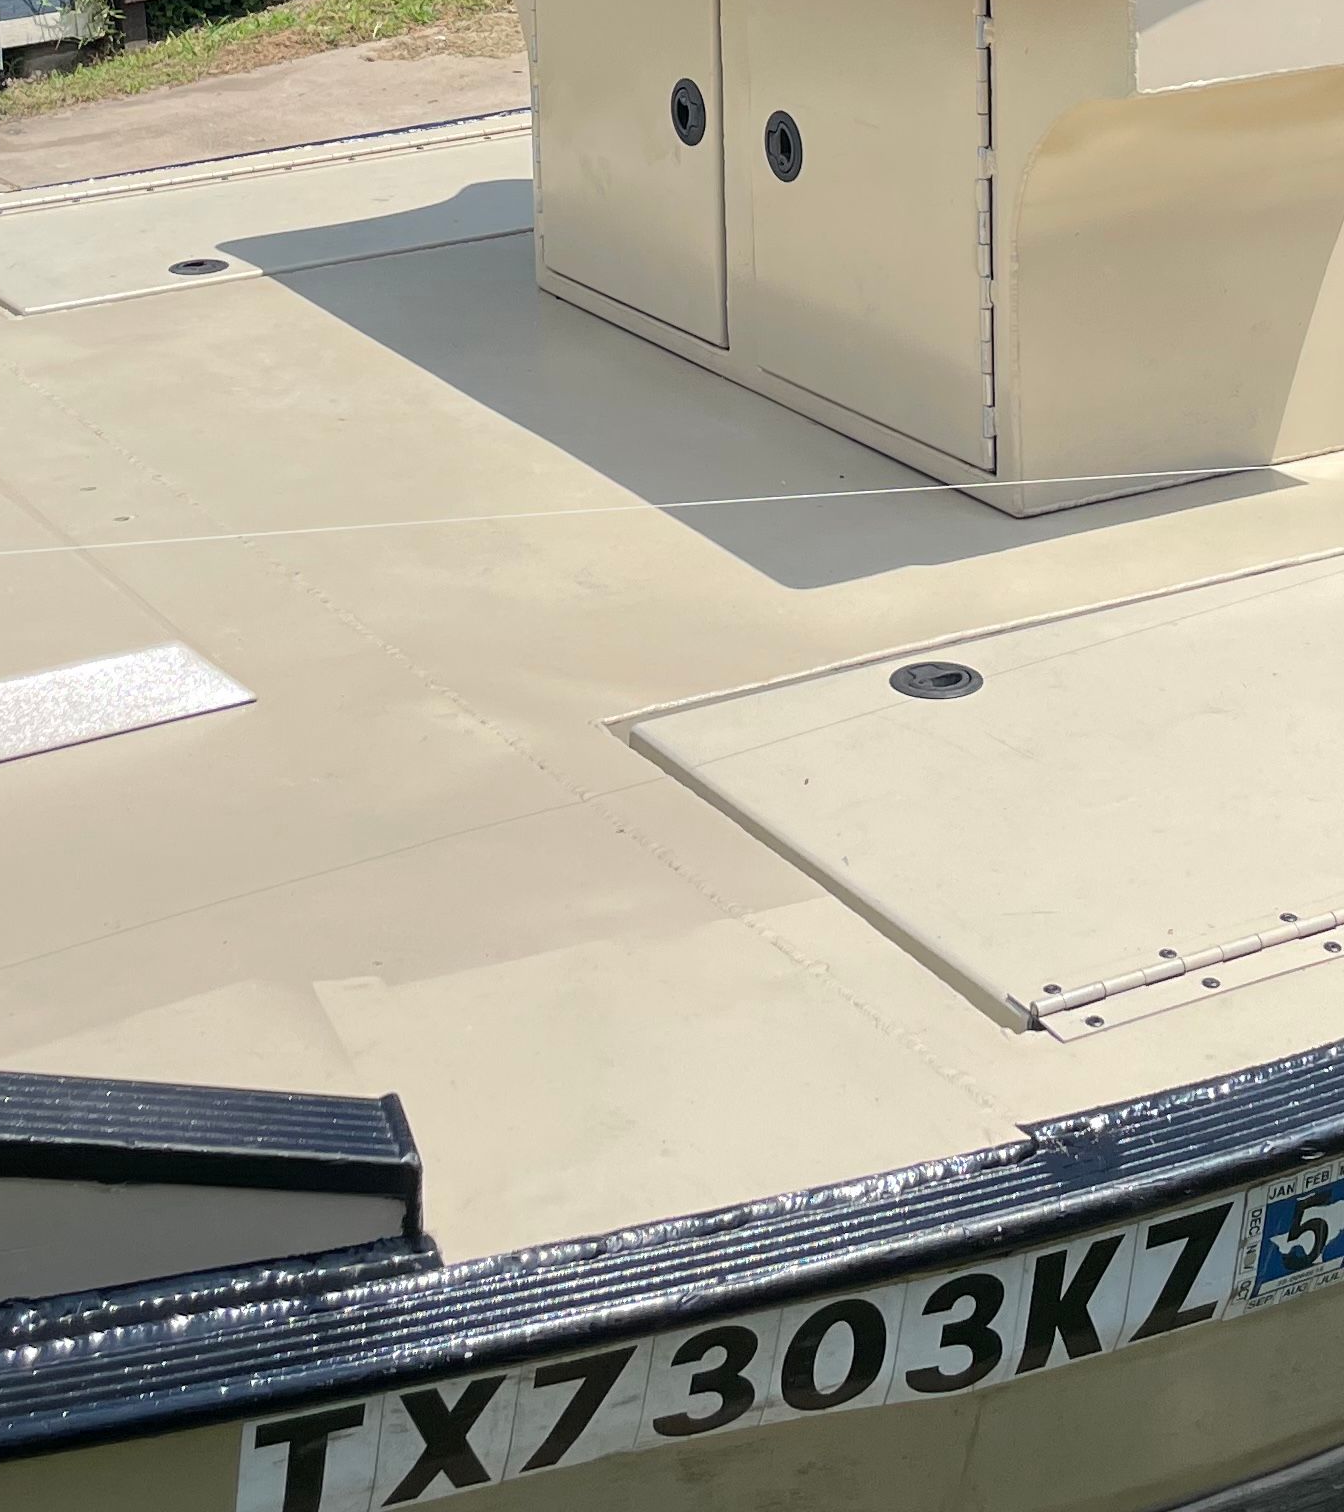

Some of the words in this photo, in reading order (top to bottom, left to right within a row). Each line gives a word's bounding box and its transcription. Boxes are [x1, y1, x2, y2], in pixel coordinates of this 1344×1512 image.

[1269, 1182, 1296, 1200] JAN
[1306, 1170, 1330, 1189] FEB
[1248, 1208, 1263, 1237] DEC
[1283, 1190, 1333, 1271] 5
